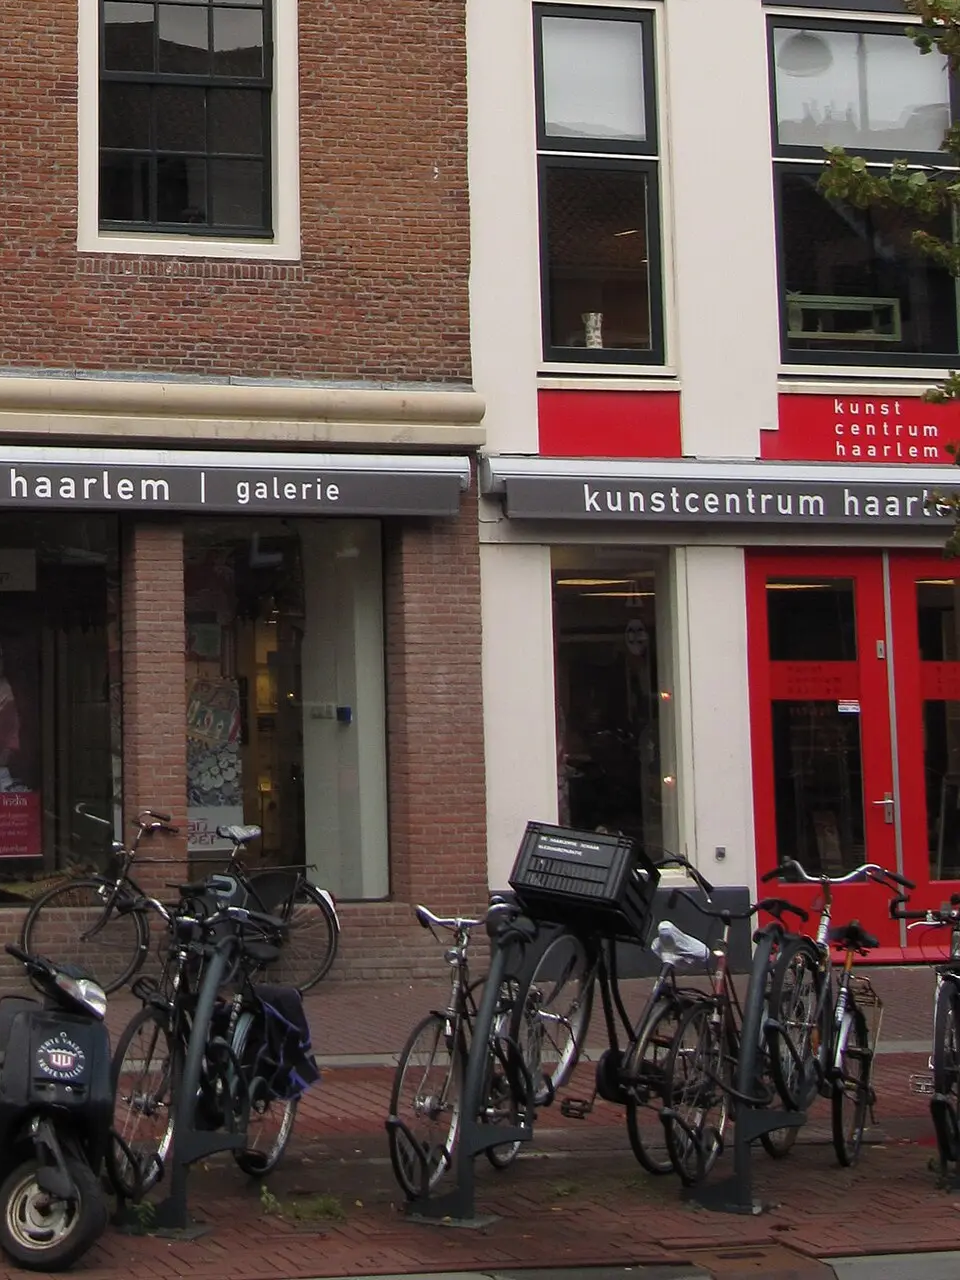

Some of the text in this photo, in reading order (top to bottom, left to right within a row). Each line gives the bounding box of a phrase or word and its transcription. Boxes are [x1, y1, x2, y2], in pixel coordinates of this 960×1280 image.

[834, 399, 900, 415] kunst
[835, 422, 938, 436] centrum
[836, 441, 938, 457] haarlem
[10, 468, 170, 501] haarlem
[236, 477, 340, 504] galerie
[584, 483, 825, 516] kunstcentrum
